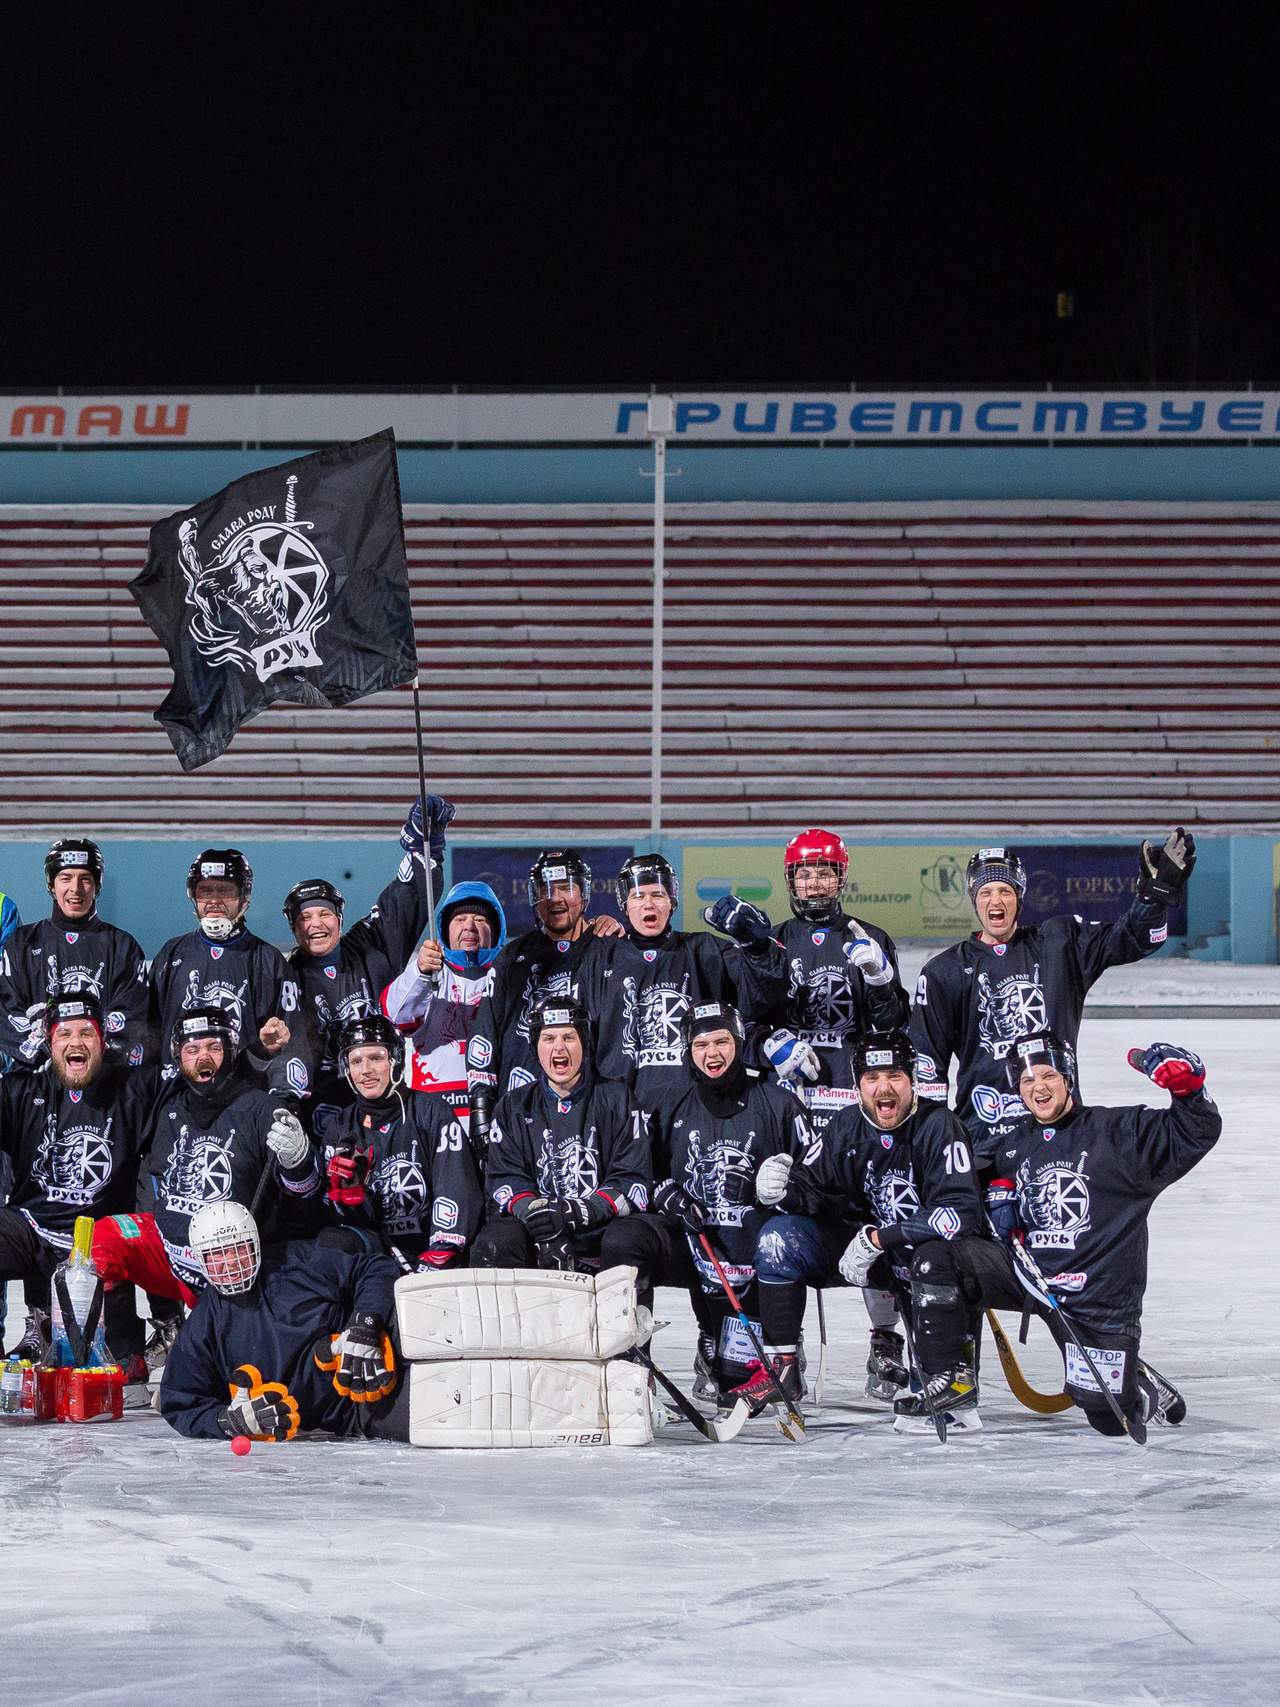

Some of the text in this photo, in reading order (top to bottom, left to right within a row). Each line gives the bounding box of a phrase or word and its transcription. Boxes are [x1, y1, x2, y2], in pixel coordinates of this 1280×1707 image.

[615, 401, 1280, 435] ПРИВЕТСТВУЕ
[211, 505, 277, 550] СЛАВА РОДУ
[841, 893, 912, 903] ТАЛИЗАТОР
[943, 1141, 972, 1175] 10
[52, 1189, 90, 1202] РУСЬ
[712, 1211, 738, 1223] УСЬ
[212, 1224, 238, 1236] JOFA
[388, 1222, 416, 1233] УСЬ
[1035, 1233, 1070, 1245] РУСЬ
[1085, 1349, 1122, 1362] ОТОР
